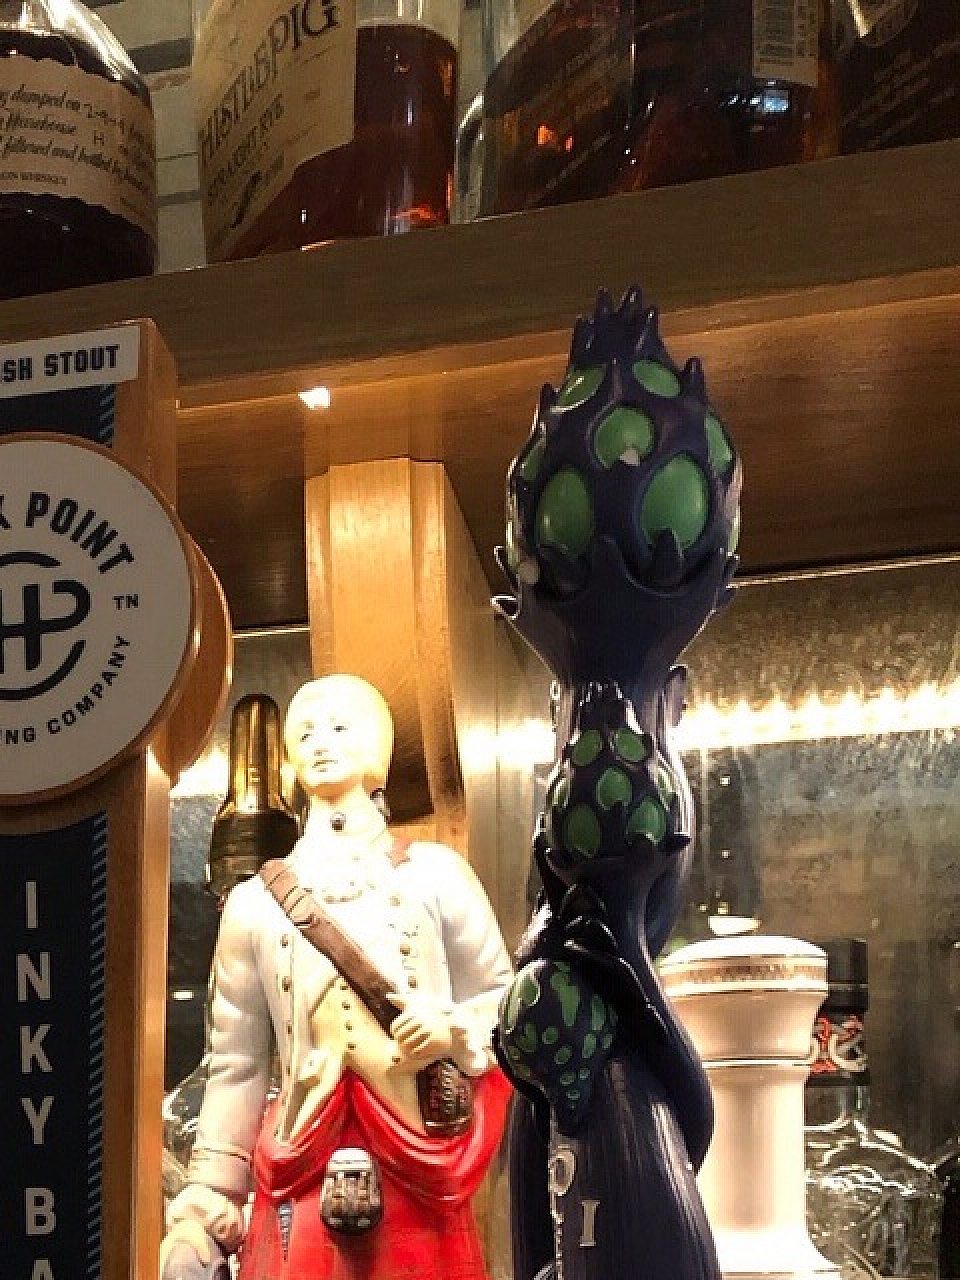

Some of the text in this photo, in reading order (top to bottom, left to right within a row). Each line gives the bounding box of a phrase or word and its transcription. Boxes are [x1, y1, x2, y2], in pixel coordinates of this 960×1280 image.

[43, 344, 120, 377] STOUT
[24, 491, 135, 575] POINT
[46, 635, 131, 735] COMPANY
[15, 881, 55, 1145] INKY
